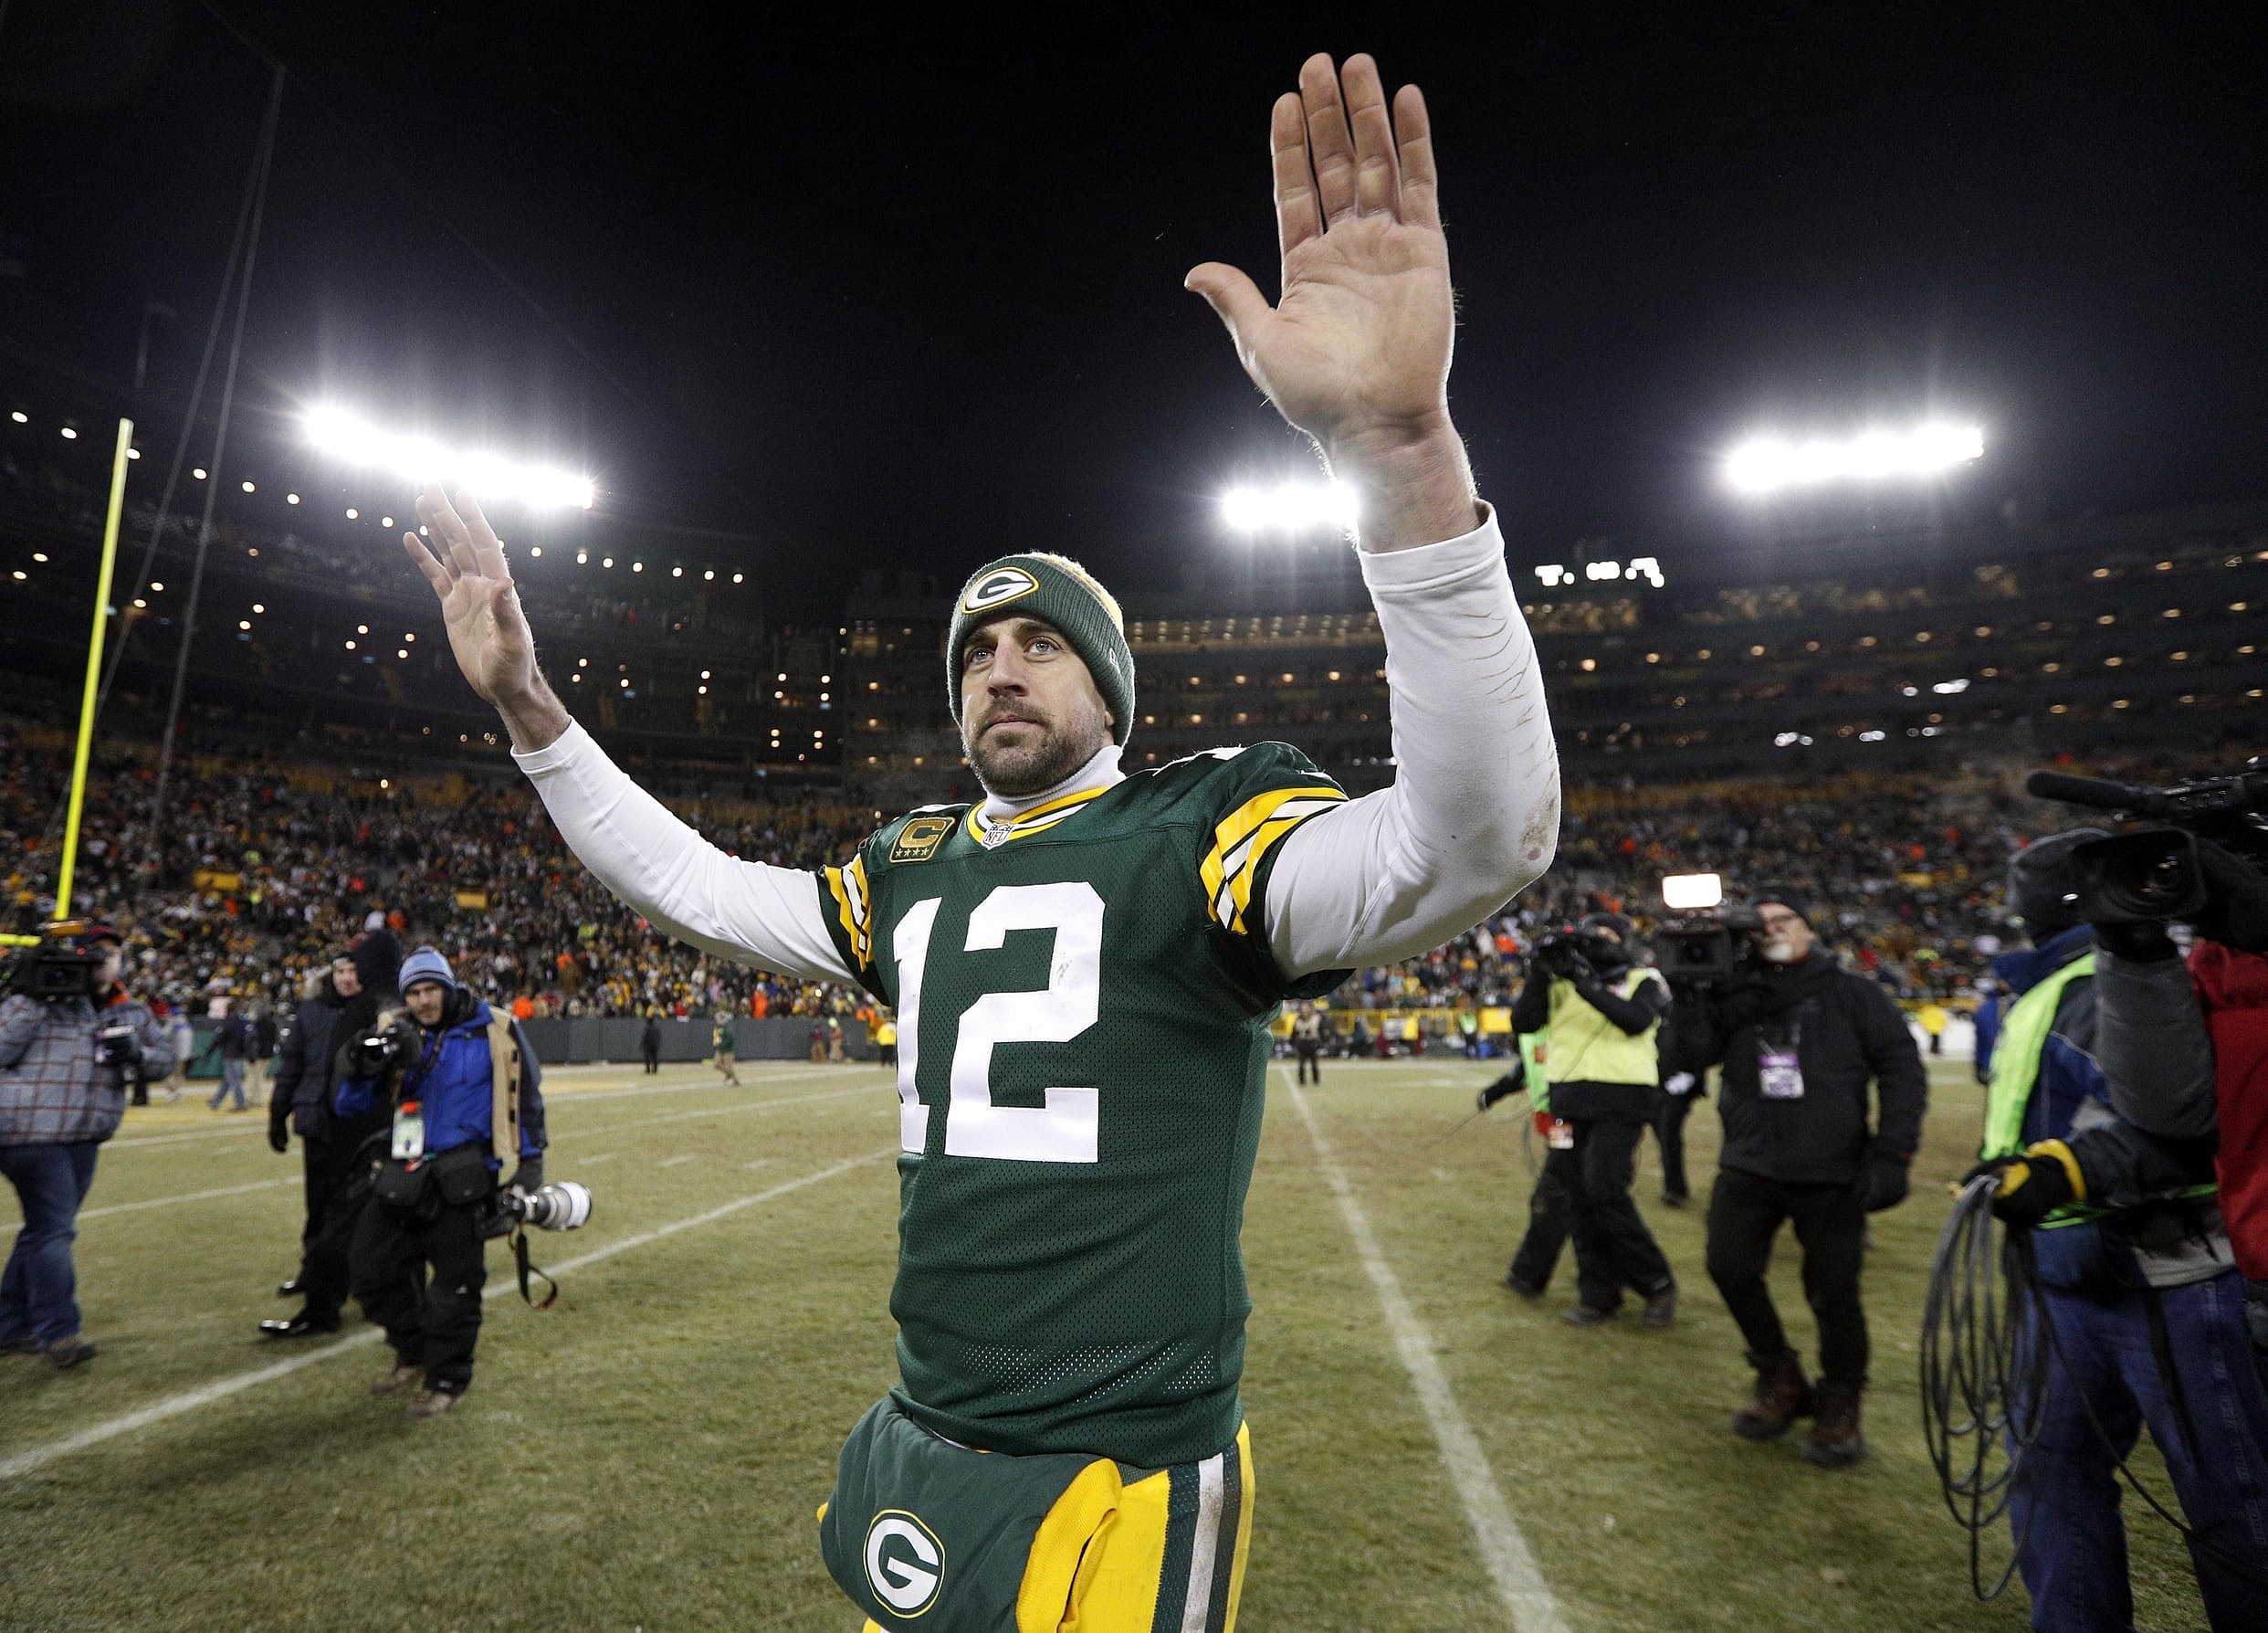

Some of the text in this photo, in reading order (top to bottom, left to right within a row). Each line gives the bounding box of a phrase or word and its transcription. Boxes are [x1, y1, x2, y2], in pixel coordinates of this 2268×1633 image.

[966, 570, 1034, 609] G
[899, 819, 947, 848] C
[985, 831, 1004, 844] NFL
[893, 881, 1106, 1163] 12
[866, 1518, 940, 1609] G
